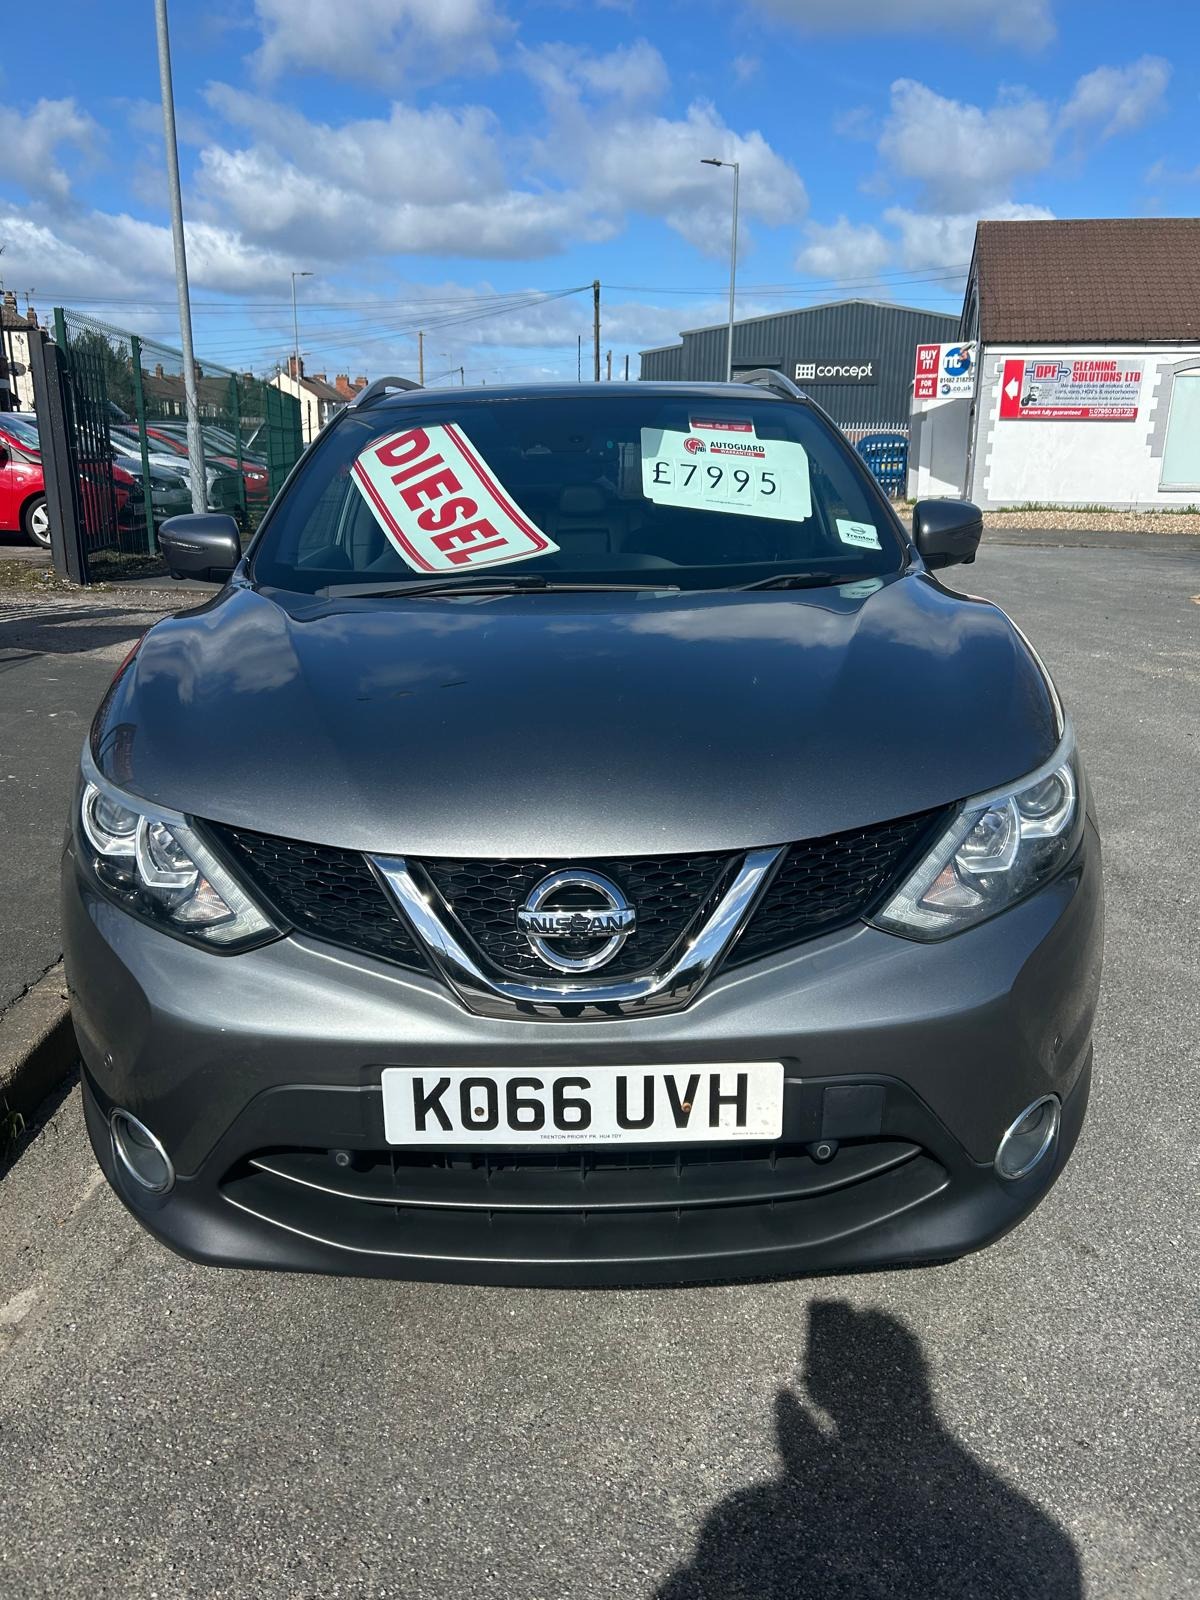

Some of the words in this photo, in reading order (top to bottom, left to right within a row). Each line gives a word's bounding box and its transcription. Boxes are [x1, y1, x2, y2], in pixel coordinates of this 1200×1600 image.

[920, 350, 937, 360] BUY
[922, 360, 934, 370] IT!
[1073, 361, 1117, 371] CLEANING
[816, 362, 872, 380] concept
[1035, 364, 1058, 379] DPF
[1072, 372, 1122, 382] SOLUTIONS
[1124, 372, 1141, 382] LTD
[710, 441, 765, 452] AUTOGUARD
[720, 449, 755, 457] WARRANTIES
[652, 461, 777, 496] £7995
[374, 426, 510, 565] DIESEL
[846, 532, 876, 542] Trenton
[530, 915, 624, 935] NISSAN
[615, 1072, 749, 1130] UVH
